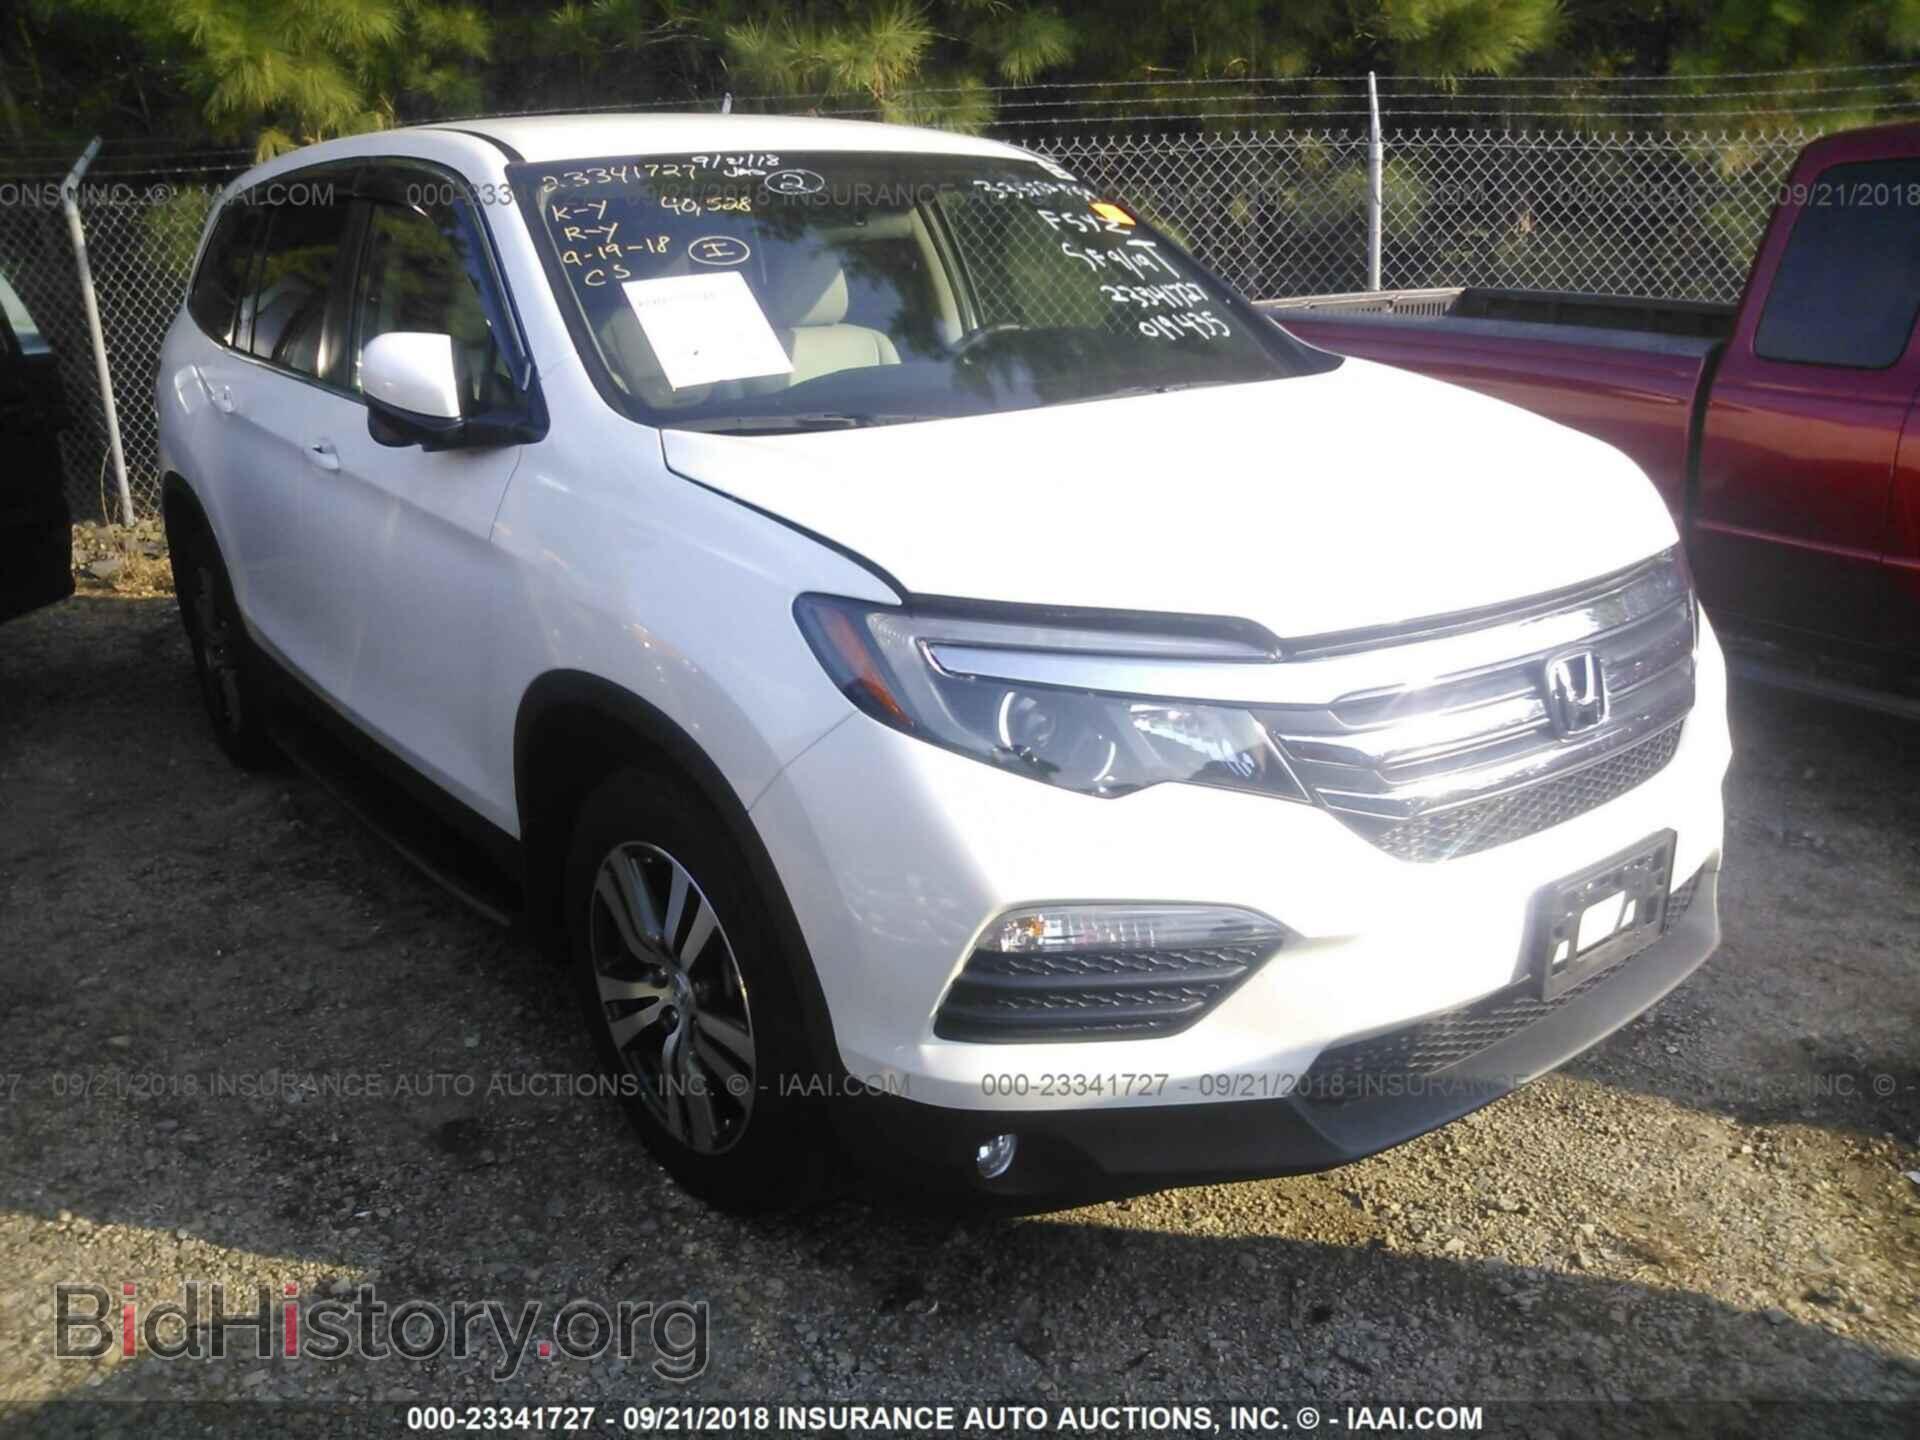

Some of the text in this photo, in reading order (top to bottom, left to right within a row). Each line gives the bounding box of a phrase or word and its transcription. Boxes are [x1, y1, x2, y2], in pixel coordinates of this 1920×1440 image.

[542, 164, 696, 193] 23341727
[660, 195, 752, 217] 40,528
[562, 235, 671, 267] 9-19-18
